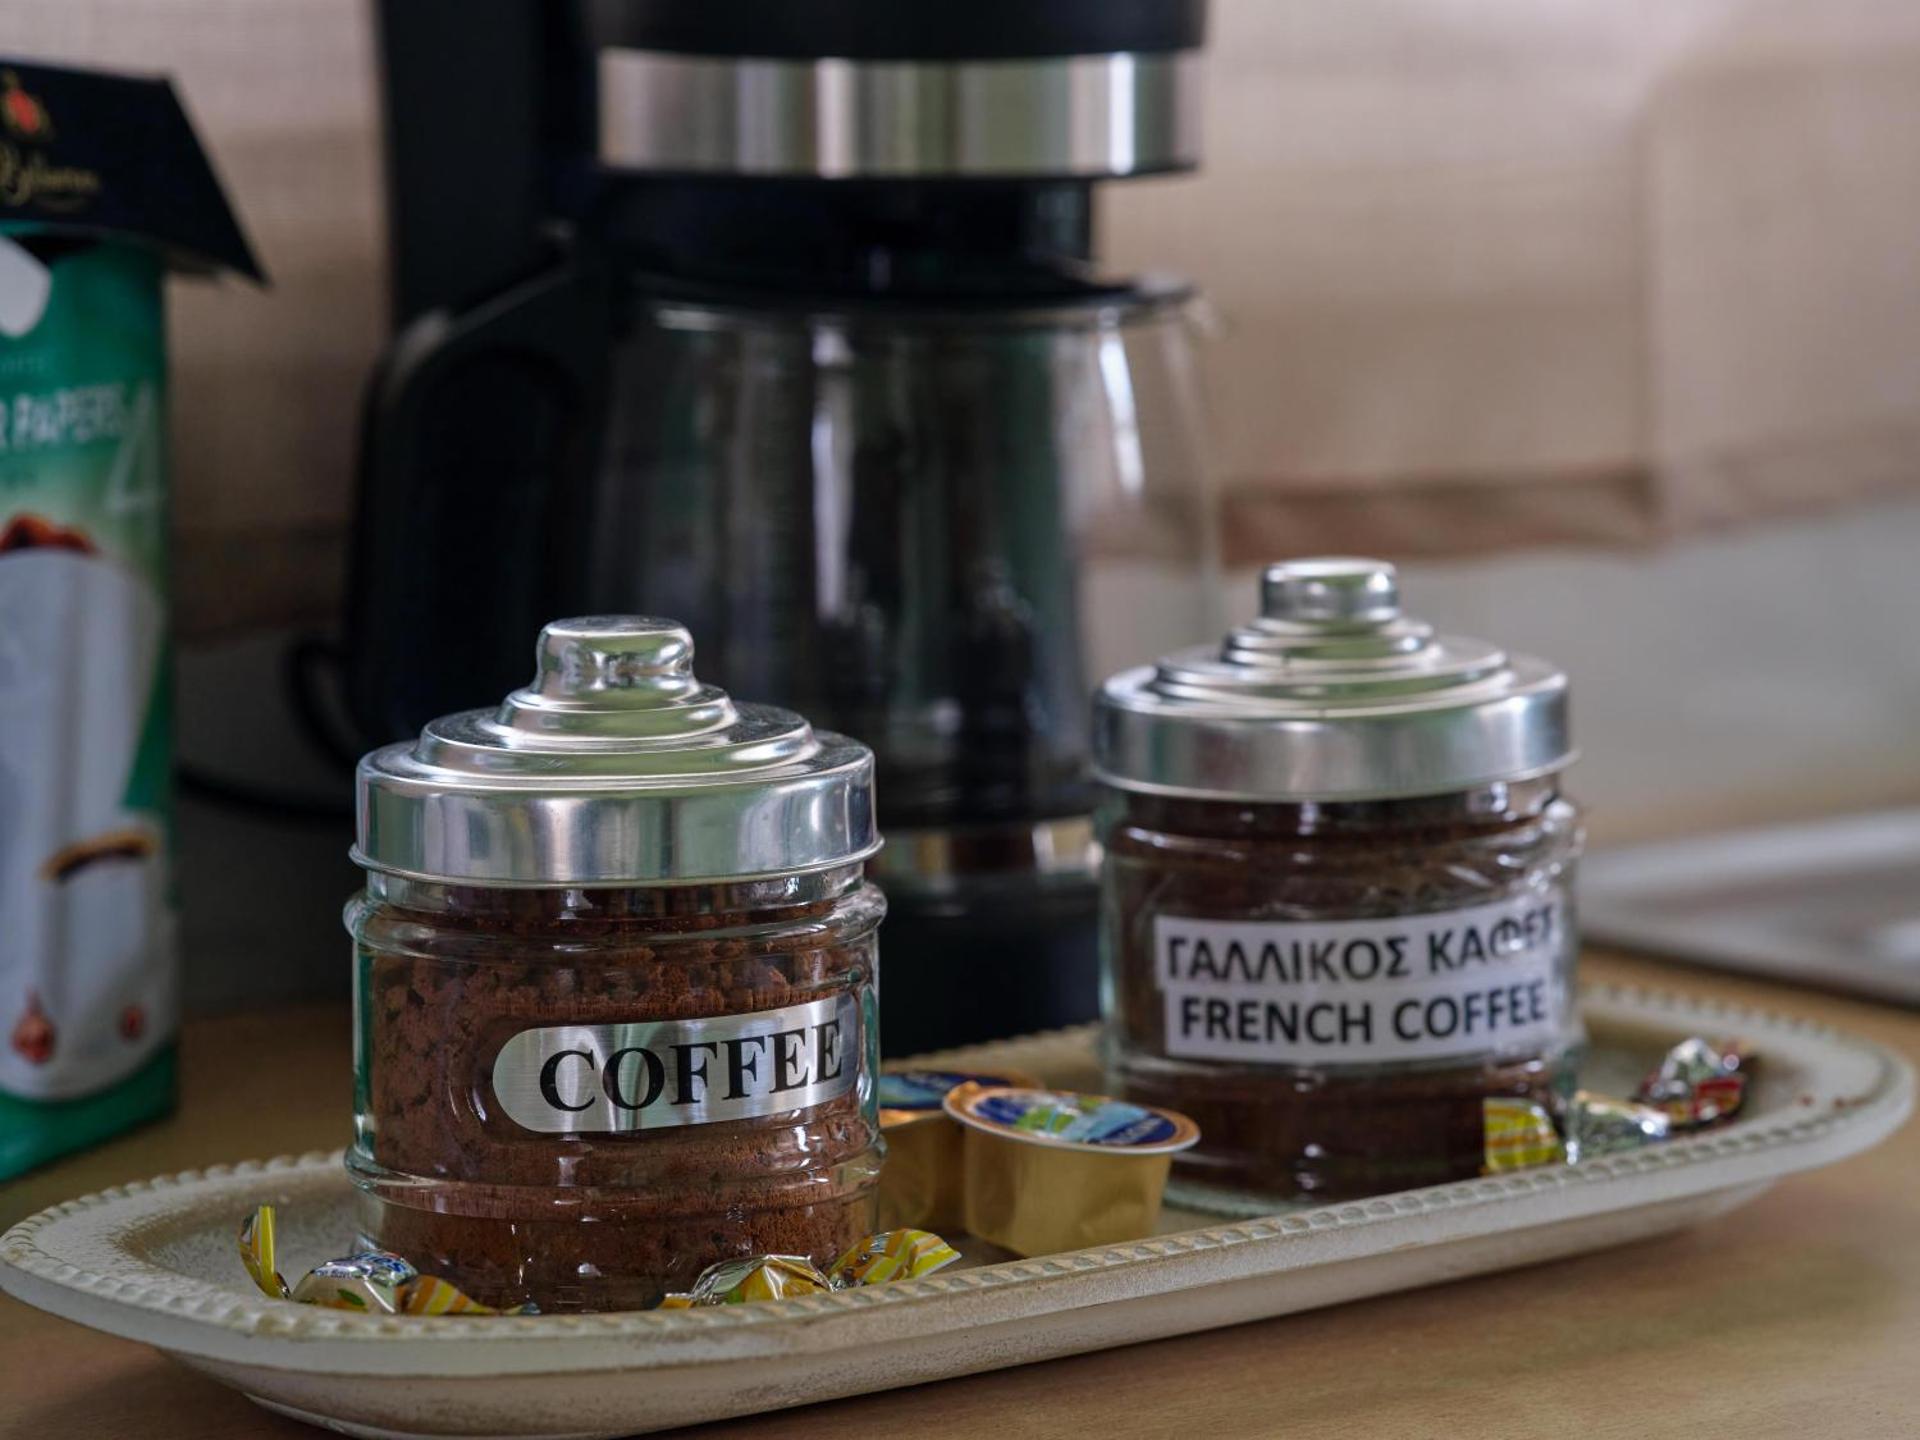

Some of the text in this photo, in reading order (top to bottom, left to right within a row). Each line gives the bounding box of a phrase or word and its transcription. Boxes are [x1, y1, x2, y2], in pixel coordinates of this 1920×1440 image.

[1167, 935, 1411, 982] ΓΑΛΛΙΚΟΣ
[1181, 980, 1546, 1044] FRENCH COFFEE
[539, 1018, 843, 1112] COFFEE
